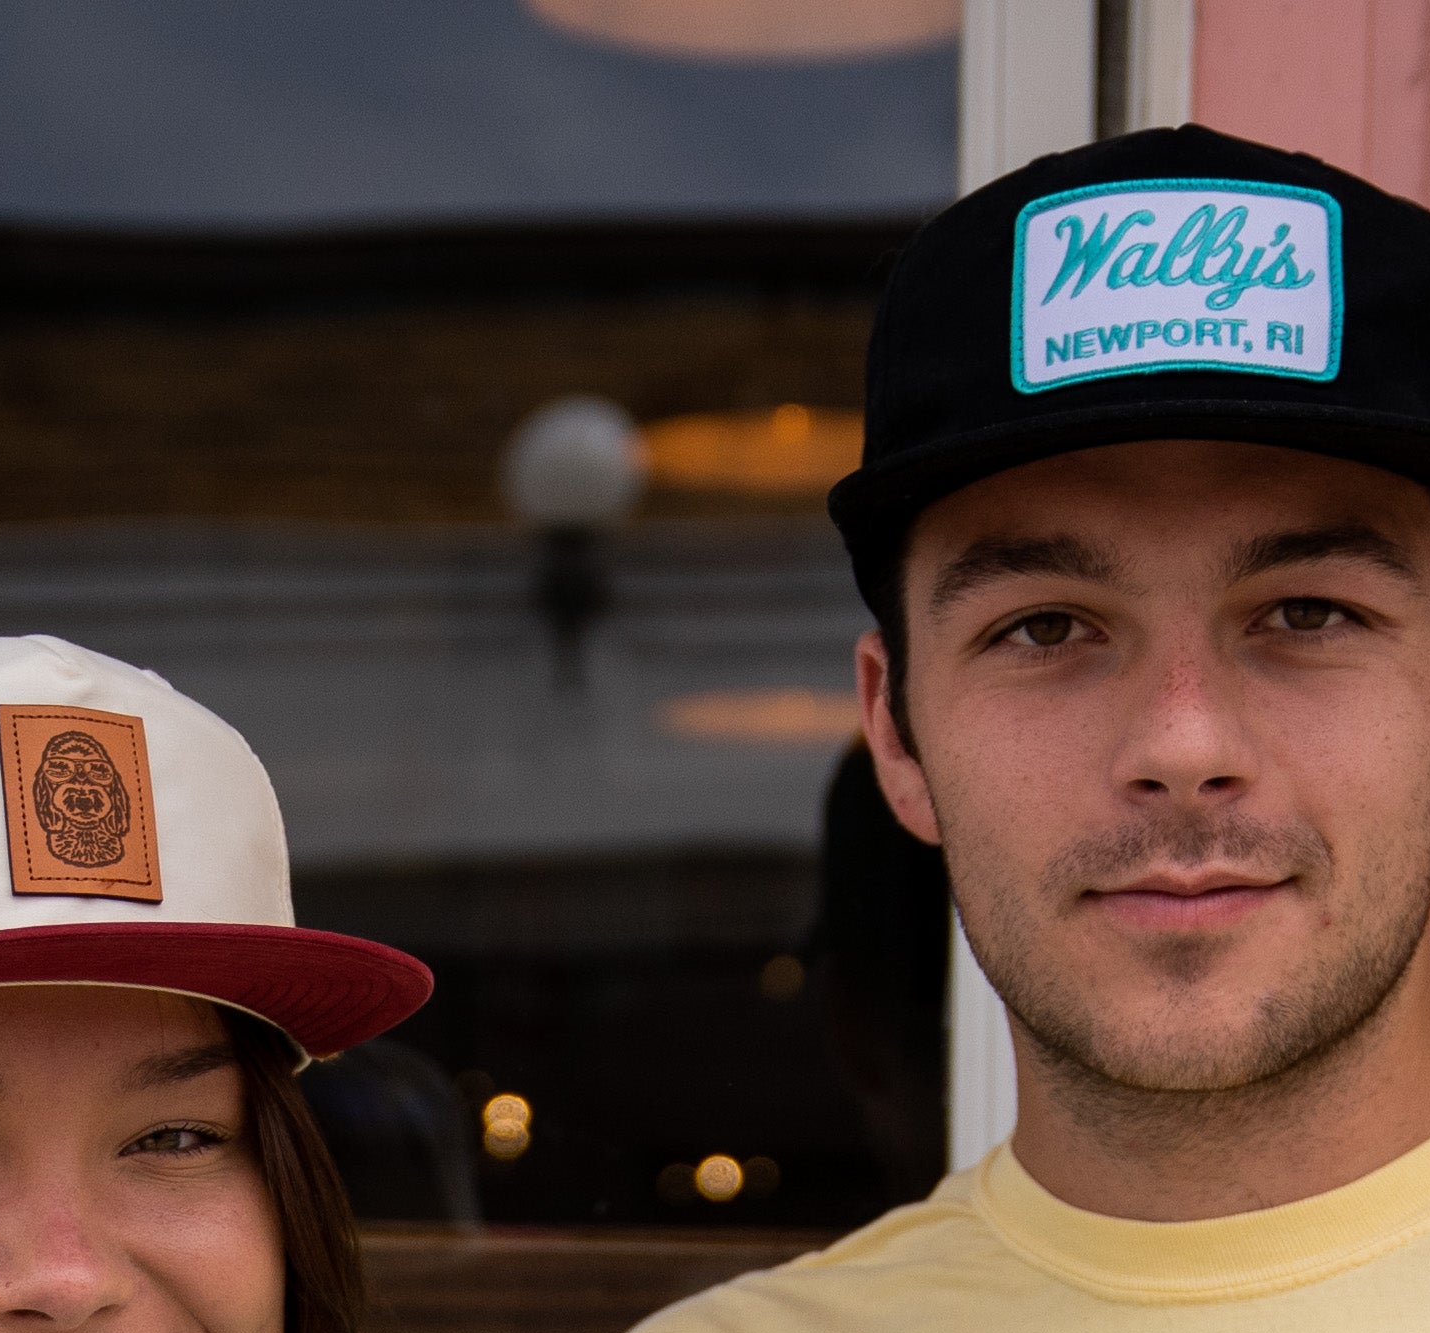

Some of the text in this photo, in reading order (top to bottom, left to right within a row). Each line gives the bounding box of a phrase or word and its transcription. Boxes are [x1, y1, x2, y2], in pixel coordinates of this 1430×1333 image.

[1041, 204, 1315, 310] Wally's
[1045, 318, 1305, 366] NEWPORT, RI
